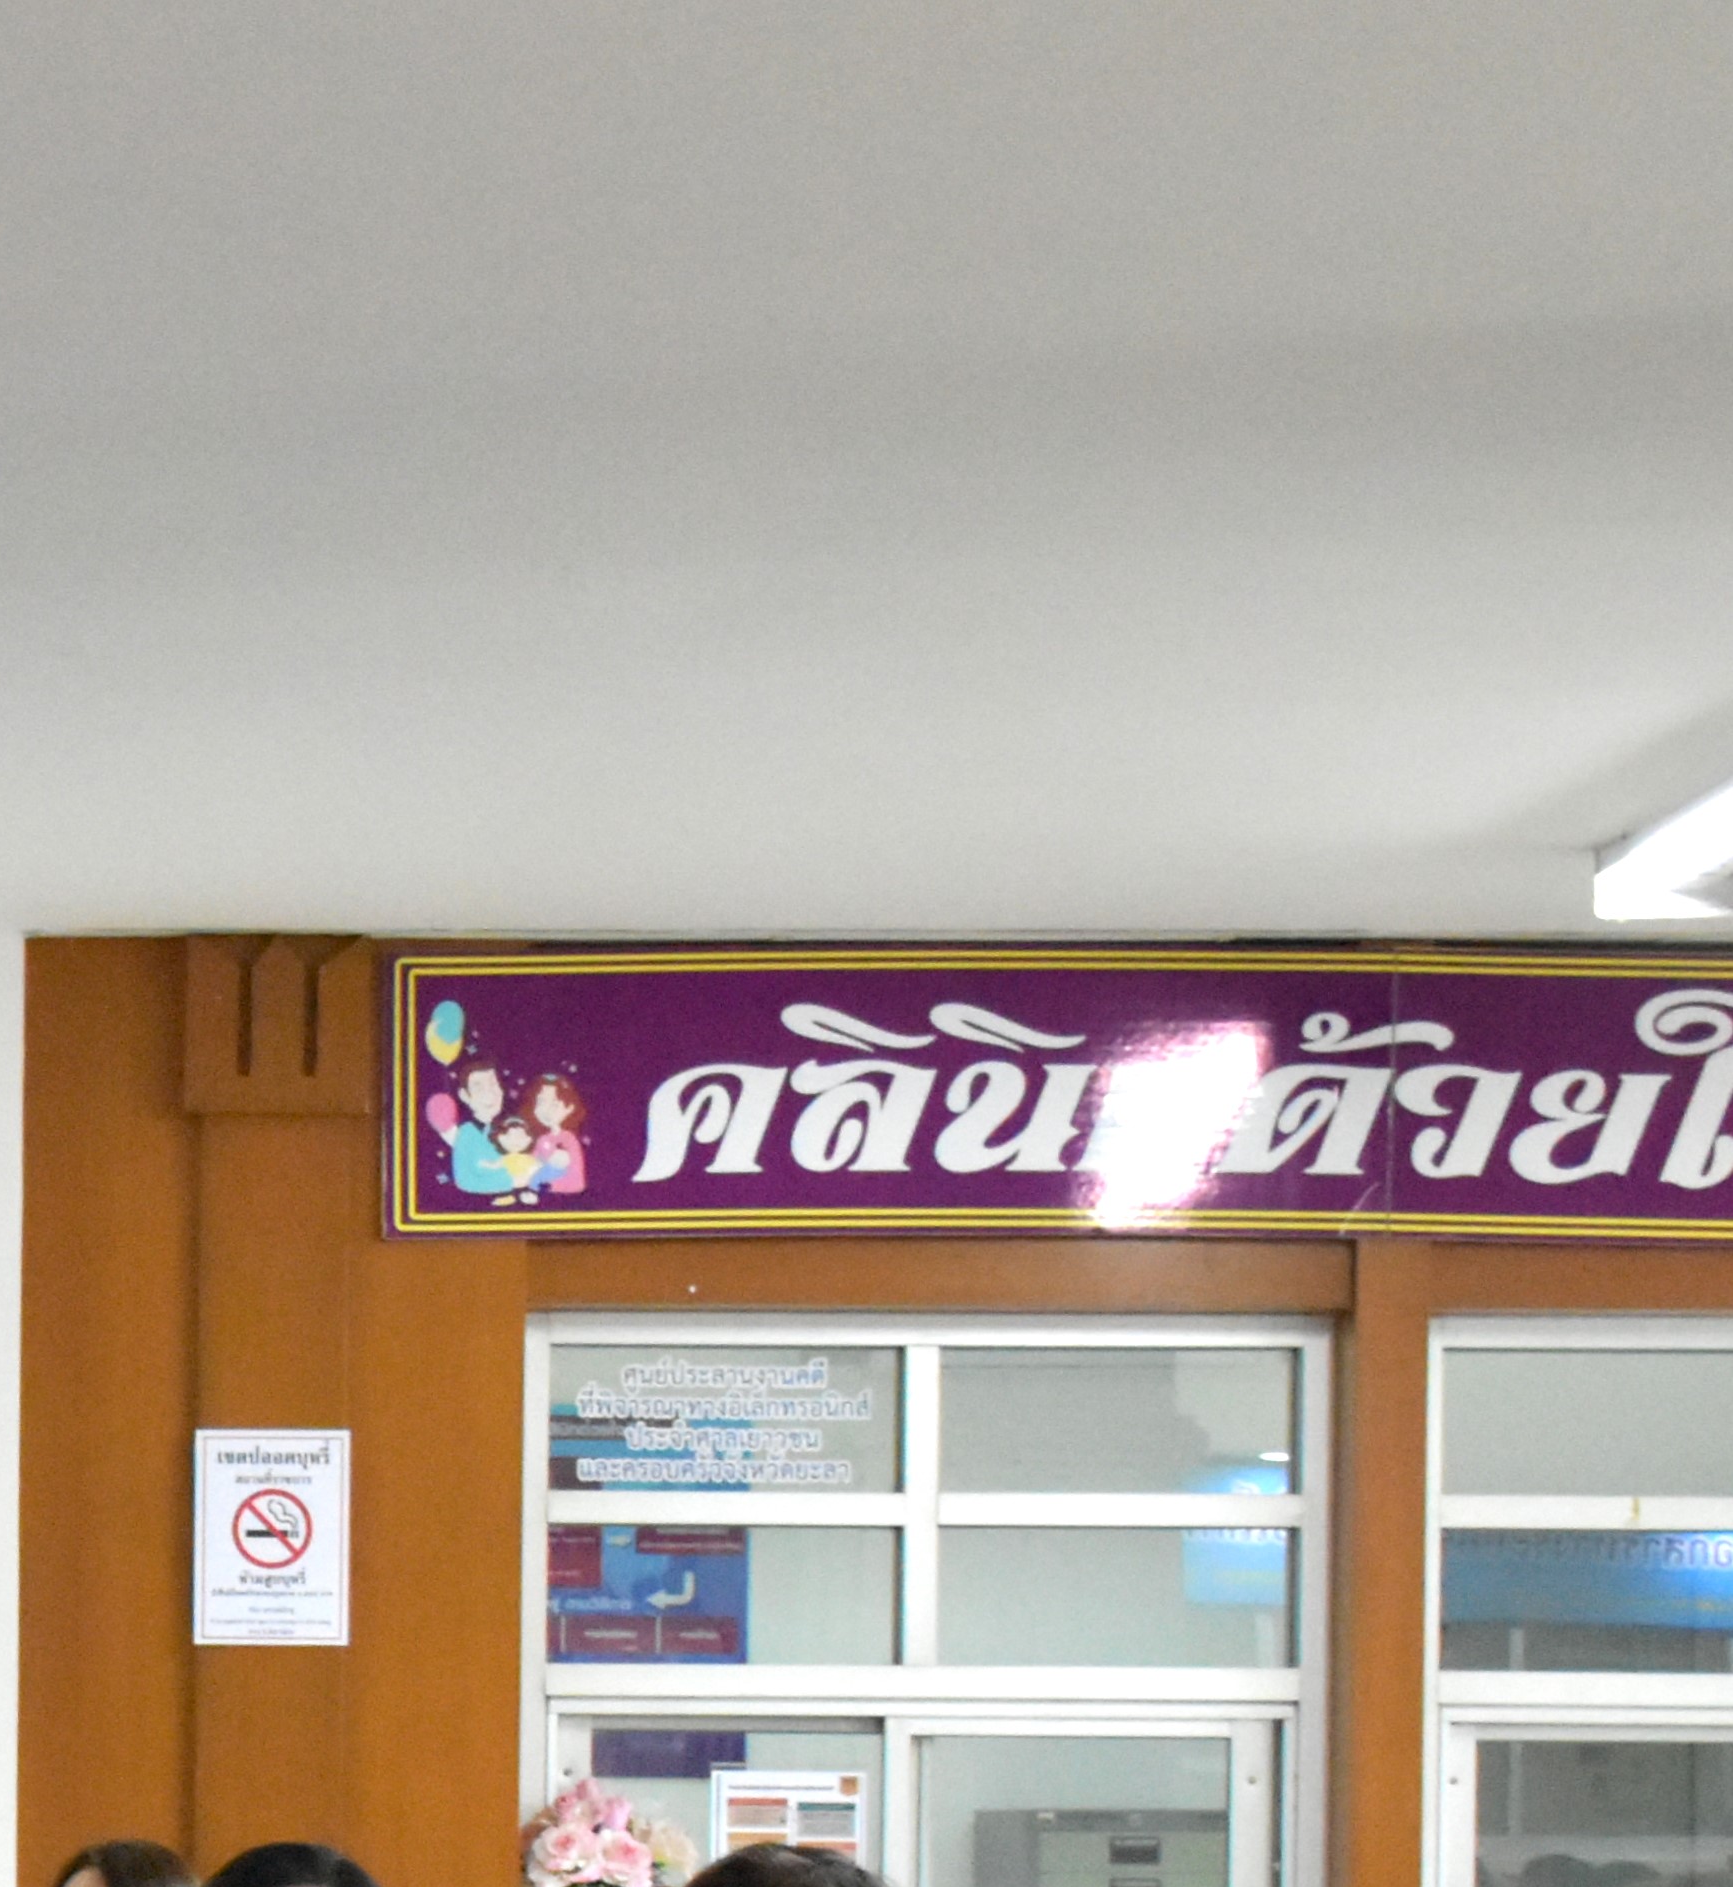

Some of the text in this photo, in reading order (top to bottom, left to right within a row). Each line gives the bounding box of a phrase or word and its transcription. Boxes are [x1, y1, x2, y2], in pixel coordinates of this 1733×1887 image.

[633, 988, 1733, 1190] คลินิด้วยใ
[216, 1441, 331, 1469] เขตปลอดบุหรี่
